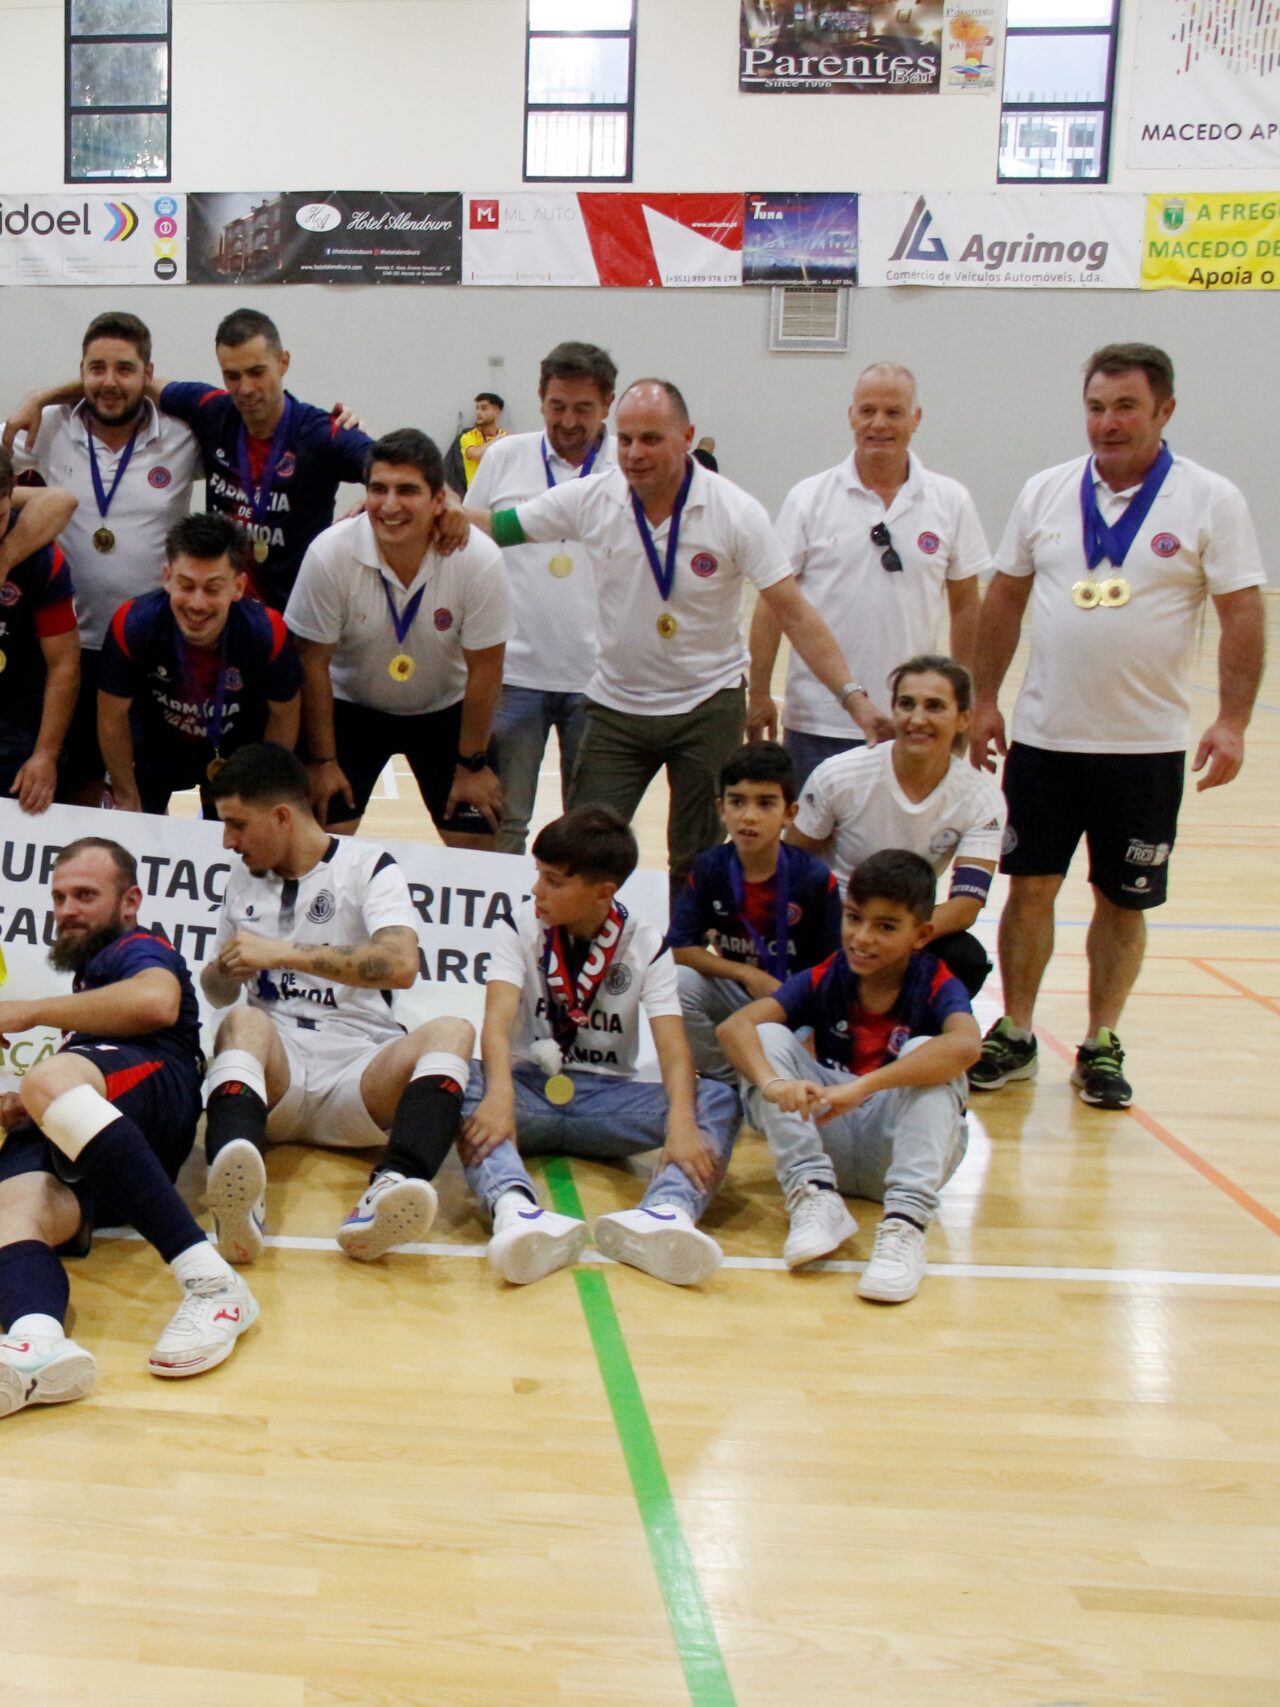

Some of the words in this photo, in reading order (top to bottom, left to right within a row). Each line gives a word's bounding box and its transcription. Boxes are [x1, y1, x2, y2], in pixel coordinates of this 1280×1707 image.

[741, 48, 937, 77] Parentes
[888, 68, 936, 84] Bar
[1141, 123, 1242, 141] MACEDO
[1249, 123, 1280, 141] AP
[347, 211, 386, 231] Hotel
[385, 211, 453, 231] Alendouro
[533, 207, 577, 221] AUTO
[1196, 204, 1212, 221] A
[1220, 202, 1280, 221] FREG
[959, 232, 1109, 271] Agrimog
[1148, 240, 1249, 259] MACEDO
[886, 270, 936, 282] Comércio
[937, 271, 952, 282] de
[954, 271, 1001, 283] Veículos
[1079, 272, 1105, 284] Lda.
[1188, 266, 1253, 290] Apoia
[1260, 271, 1275, 285] o
[281, 972, 296, 985] DE
